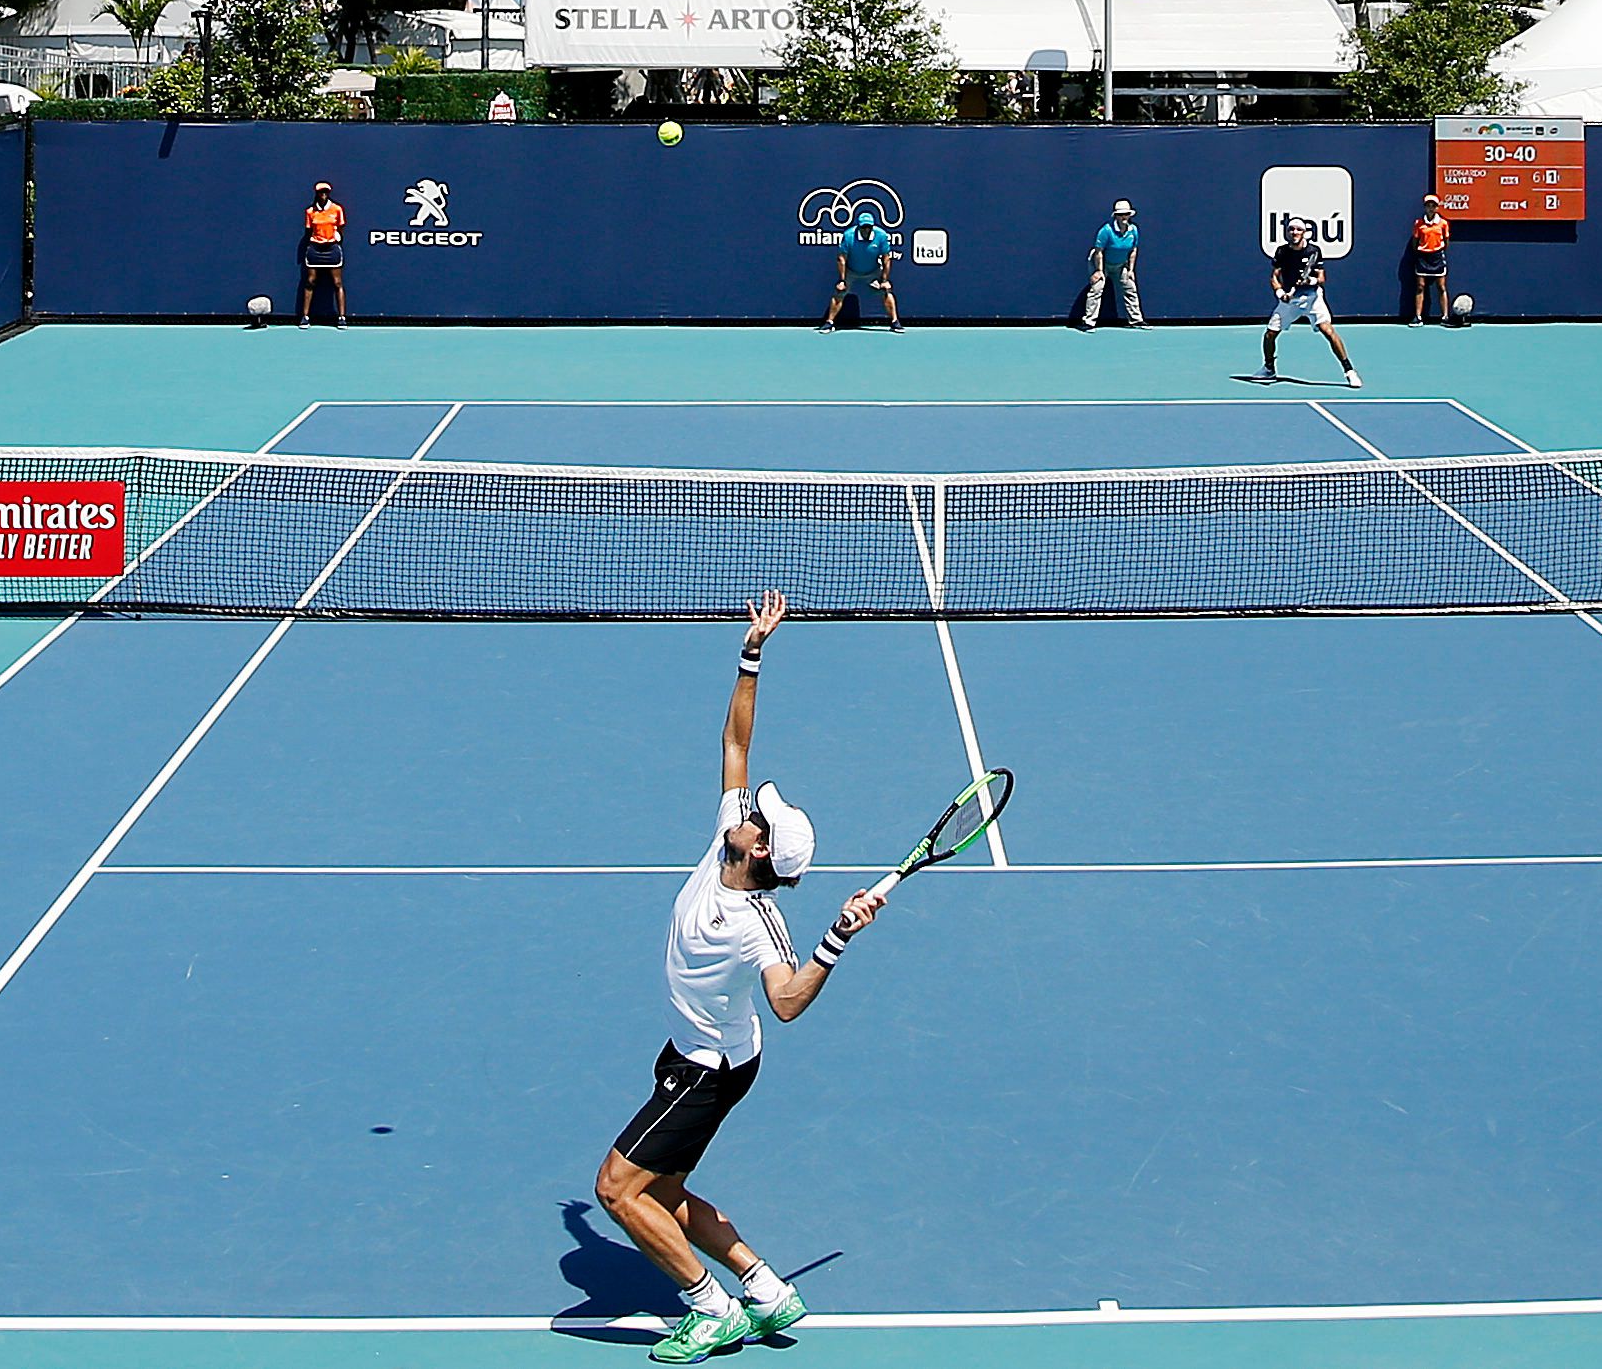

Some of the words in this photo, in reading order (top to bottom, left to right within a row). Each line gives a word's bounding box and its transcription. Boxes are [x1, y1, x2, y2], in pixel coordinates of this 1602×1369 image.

[554, 7, 669, 31] STELLA
[706, 7, 796, 31] ARTO
[1484, 145, 1536, 162] 30-40
[1532, 171, 1541, 183] 6
[1443, 194, 1470, 202] GUIDO
[1443, 202, 1470, 210] PELLA
[369, 230, 483, 246] PEUGEOT
[916, 246, 944, 259] Itaú
[23, 533, 92, 560] BETTER
